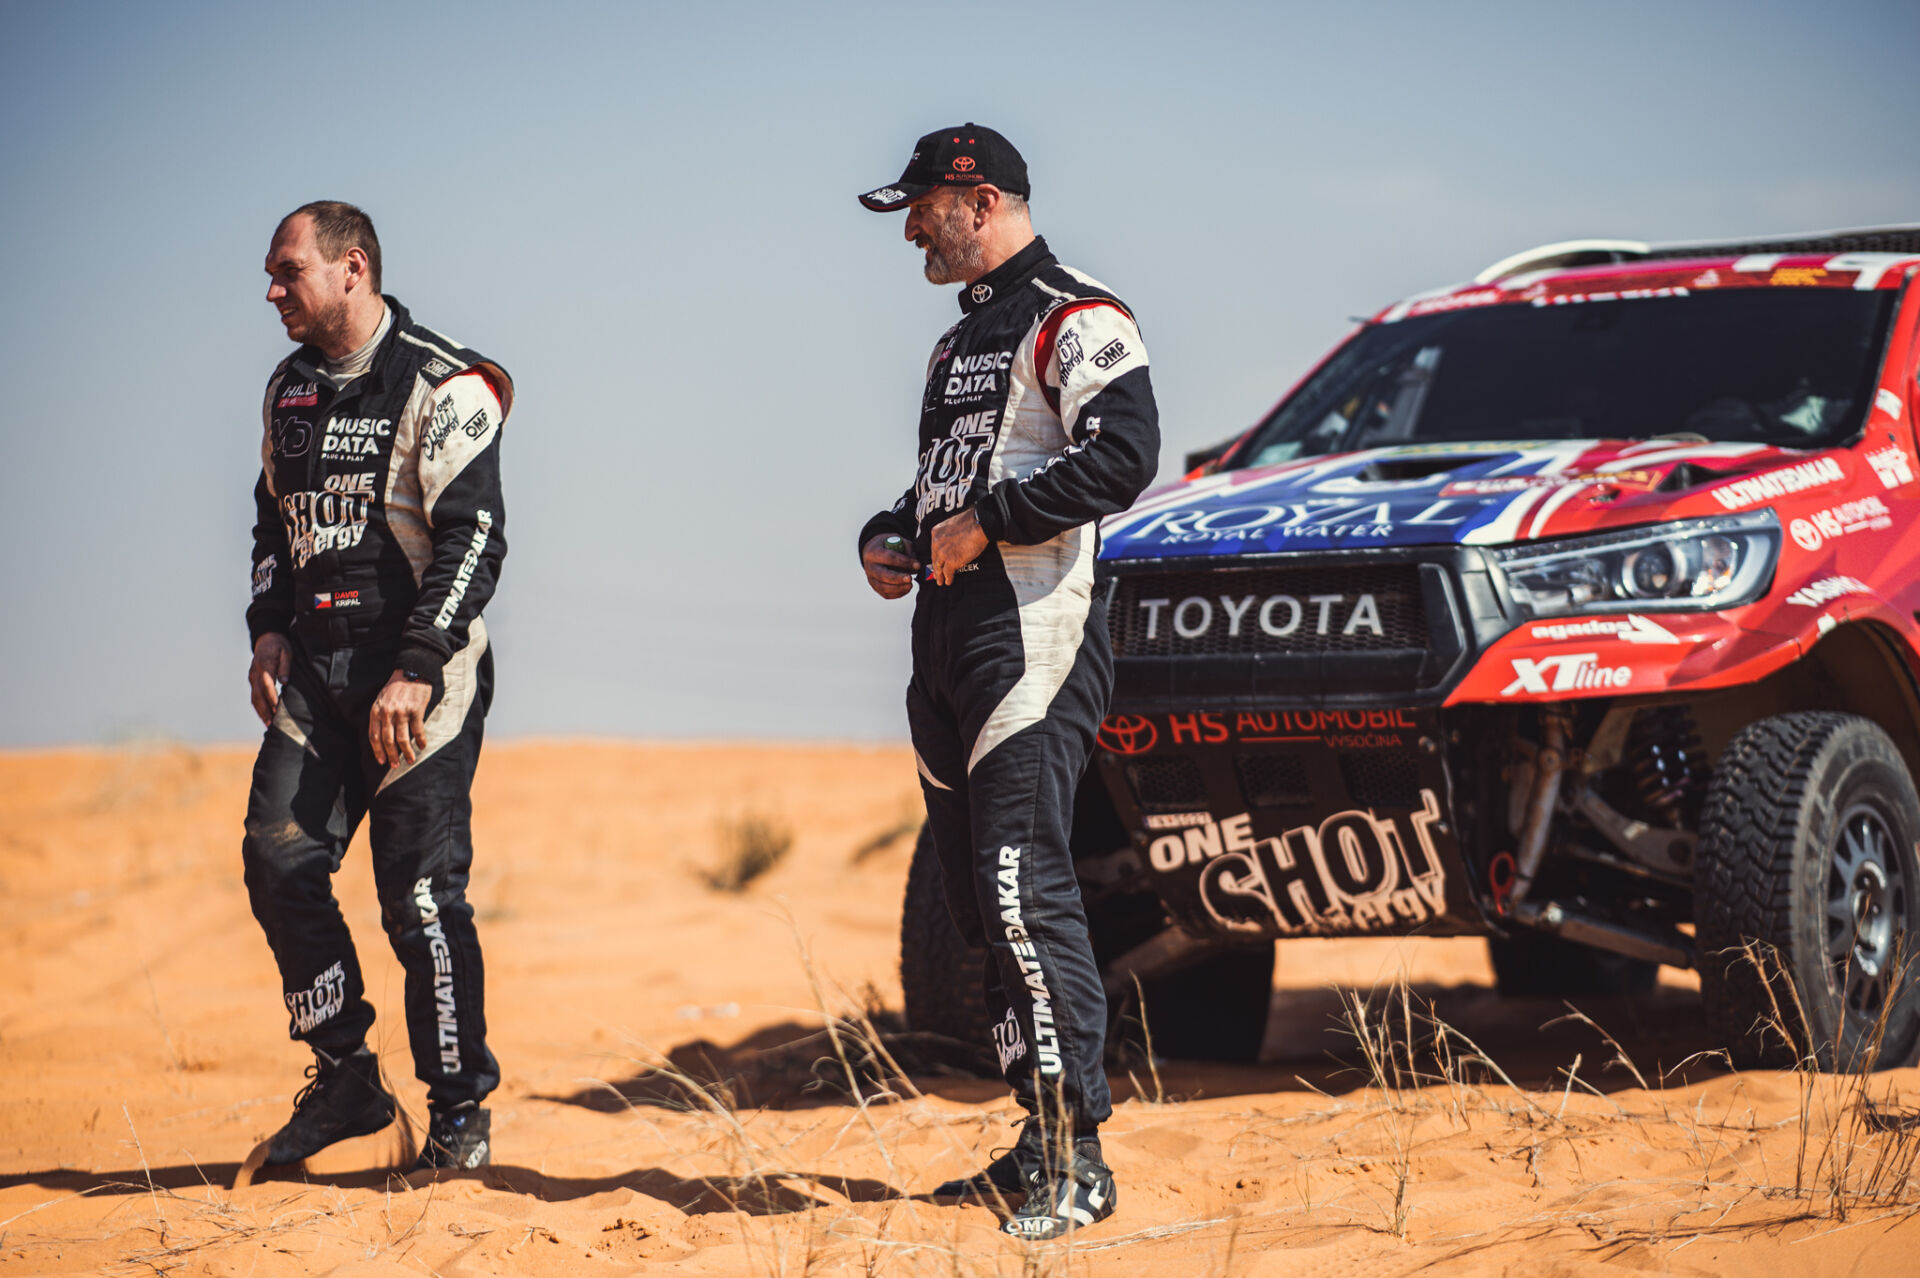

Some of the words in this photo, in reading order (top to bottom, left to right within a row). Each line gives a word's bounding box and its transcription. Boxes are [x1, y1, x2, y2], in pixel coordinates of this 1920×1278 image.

[1057, 327, 1076, 348] ONE
[950, 351, 1013, 374] MUSIC
[1094, 341, 1125, 369] OMP
[944, 373, 997, 396] DATA
[436, 392, 453, 413] ONE
[326, 415, 392, 437] MUSIC
[465, 411, 489, 438] OMP
[949, 409, 998, 437] ONE
[321, 434, 380, 455] DATA
[323, 471, 377, 492] ONE
[1128, 500, 1466, 540] ROYAL
[1160, 530, 1266, 545] ROYAL
[1282, 523, 1395, 539] WATER
[334, 590, 359, 600] DAVID
[1139, 593, 1384, 640] TOYOTA
[1168, 713, 1230, 745] HS
[1149, 812, 1255, 872] ONE
[1199, 788, 1444, 933] SHOT
[997, 845, 1063, 1075] ULTIMATEDAKAR
[314, 959, 342, 988] ONE
[1006, 1220, 1055, 1233] OMP
